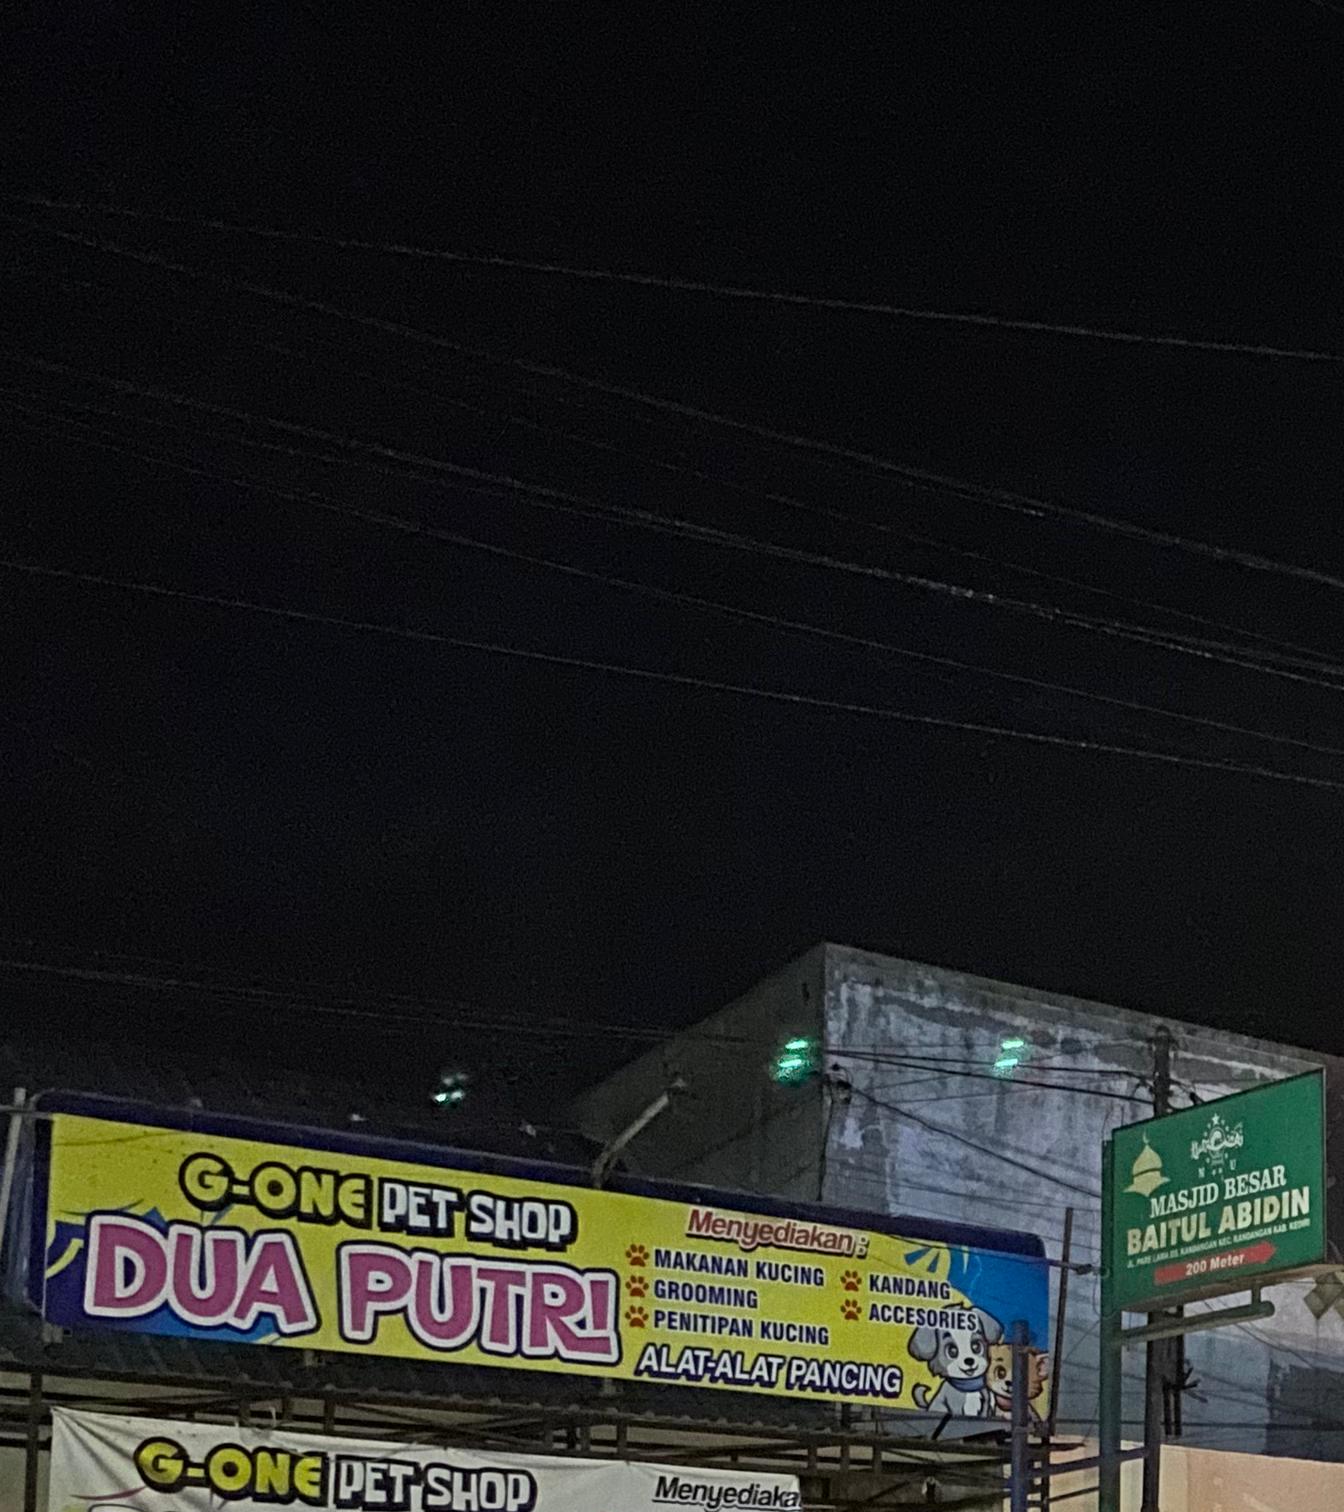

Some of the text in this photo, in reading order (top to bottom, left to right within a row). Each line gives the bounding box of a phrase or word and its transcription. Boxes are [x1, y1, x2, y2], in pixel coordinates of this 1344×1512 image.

[182, 1155, 574, 1246] G-ONE PET SHOP
[1150, 1164, 1286, 1218] MASJID BESAR
[1127, 1186, 1310, 1256] BAITUL ABIDIN
[86, 1215, 317, 1333] DUA
[654, 1249, 824, 1286] MAKANAN KUCING
[1186, 1252, 1245, 1277] 200 Meter
[654, 1279, 758, 1309] GROOMING
[869, 1273, 951, 1300] KANDANG
[654, 1309, 829, 1345] PENITIPAN KUCING
[869, 1303, 978, 1331] ACCESORIES
[638, 1345, 901, 1394] ALAT-ALAT PANCING
[138, 1440, 325, 1502] G-ONE
[338, 1459, 416, 1506] PET
[655, 1475, 802, 1508] Menyediaka
